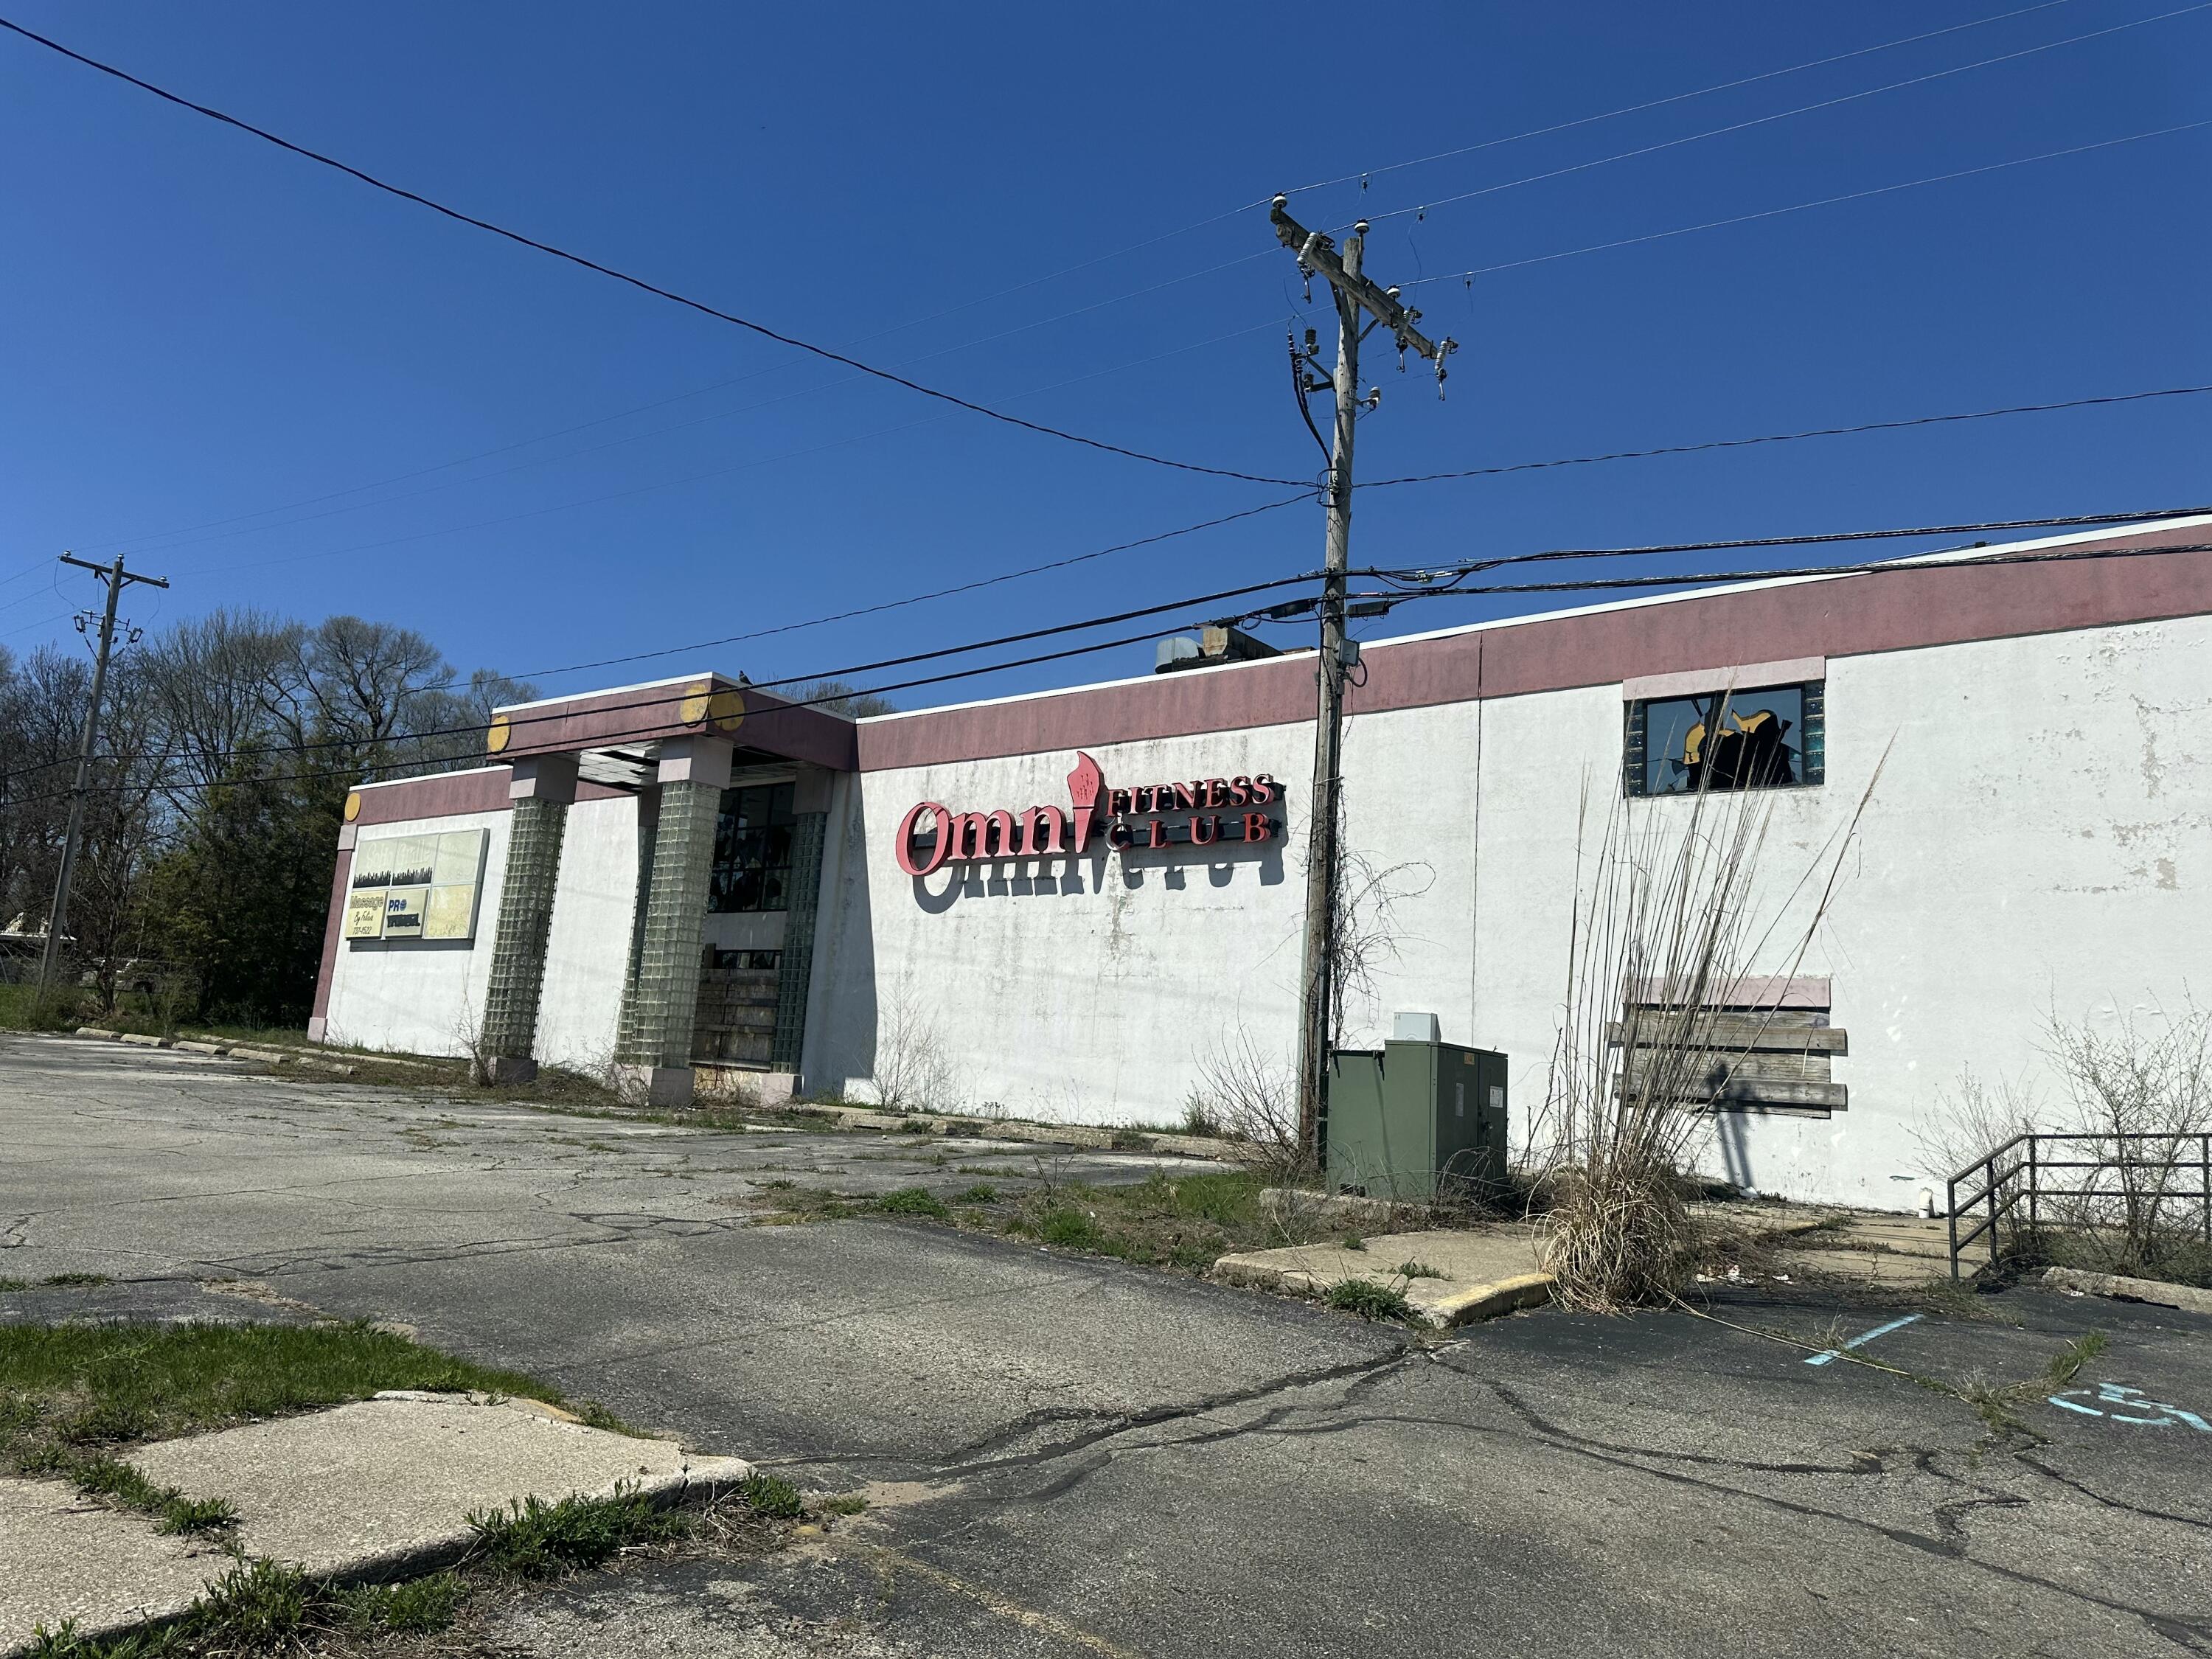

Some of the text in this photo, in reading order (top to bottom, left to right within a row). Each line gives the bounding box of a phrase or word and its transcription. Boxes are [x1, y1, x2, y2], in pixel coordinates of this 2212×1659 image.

[896, 751, 1105, 876] Omni
[1105, 773, 1274, 818] FITNESS
[1105, 812, 1271, 852] CLUB
[349, 895, 383, 911] Massage
